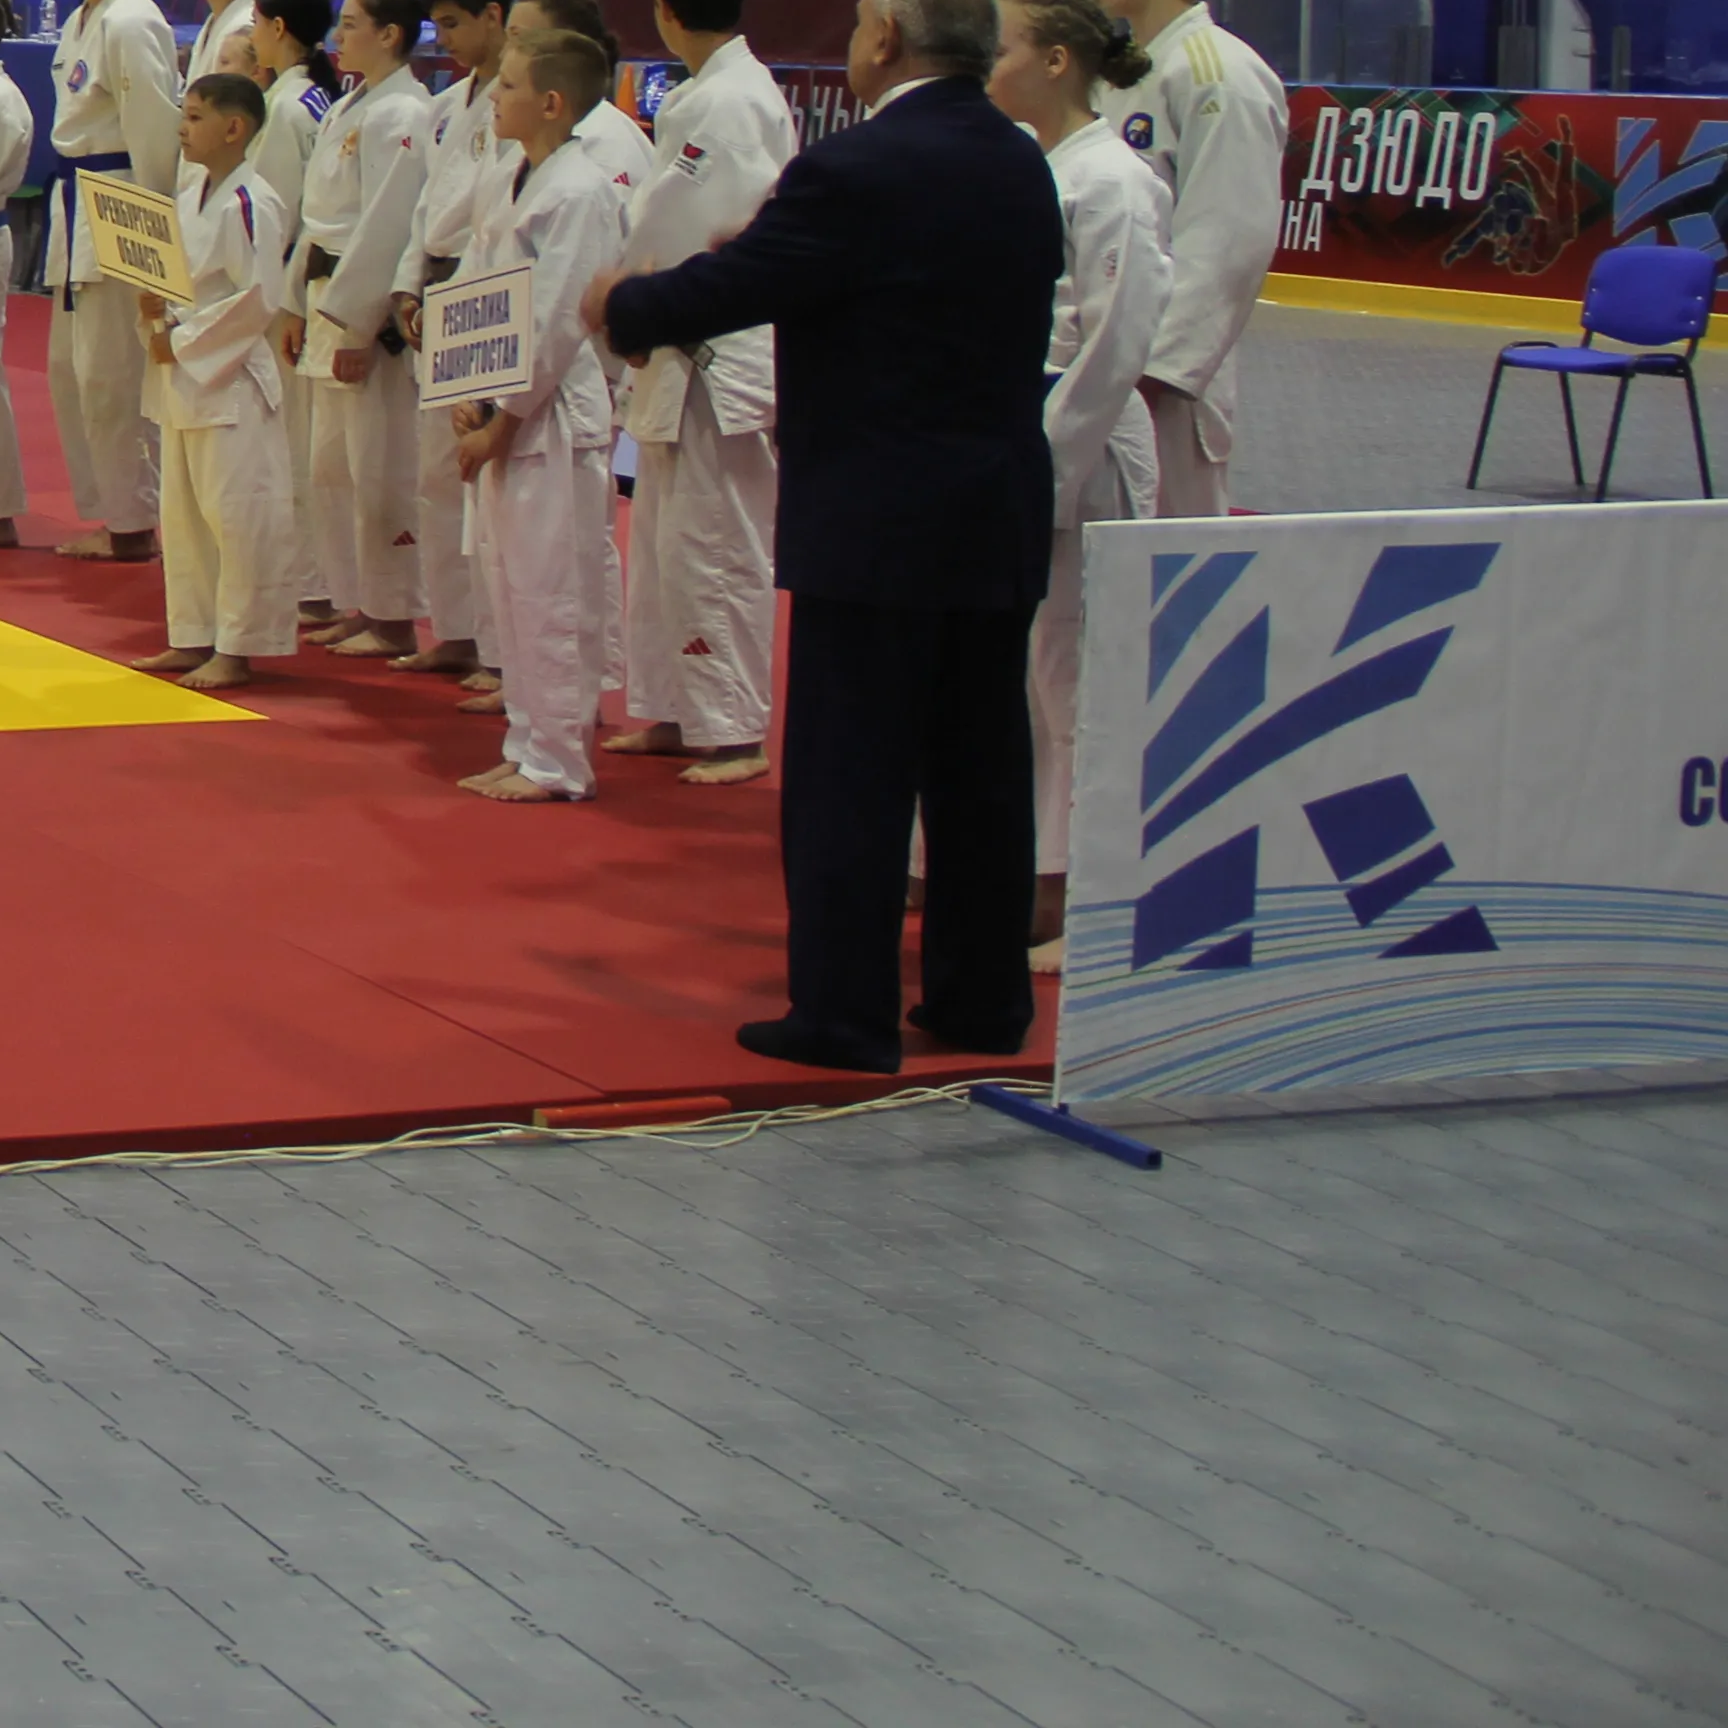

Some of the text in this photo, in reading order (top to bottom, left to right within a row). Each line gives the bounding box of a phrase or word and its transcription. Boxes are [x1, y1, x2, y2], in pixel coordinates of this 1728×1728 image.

[1300, 106, 1496, 210] ДЗЮДО
[93, 191, 173, 245] ОРЕНБУРГСКАЯ
[116, 234, 166, 280] ОБЛАСТЬ
[442, 289, 510, 338] РЕСПУБЛИКА
[432, 333, 519, 384] БАШКОРТОСТАН
